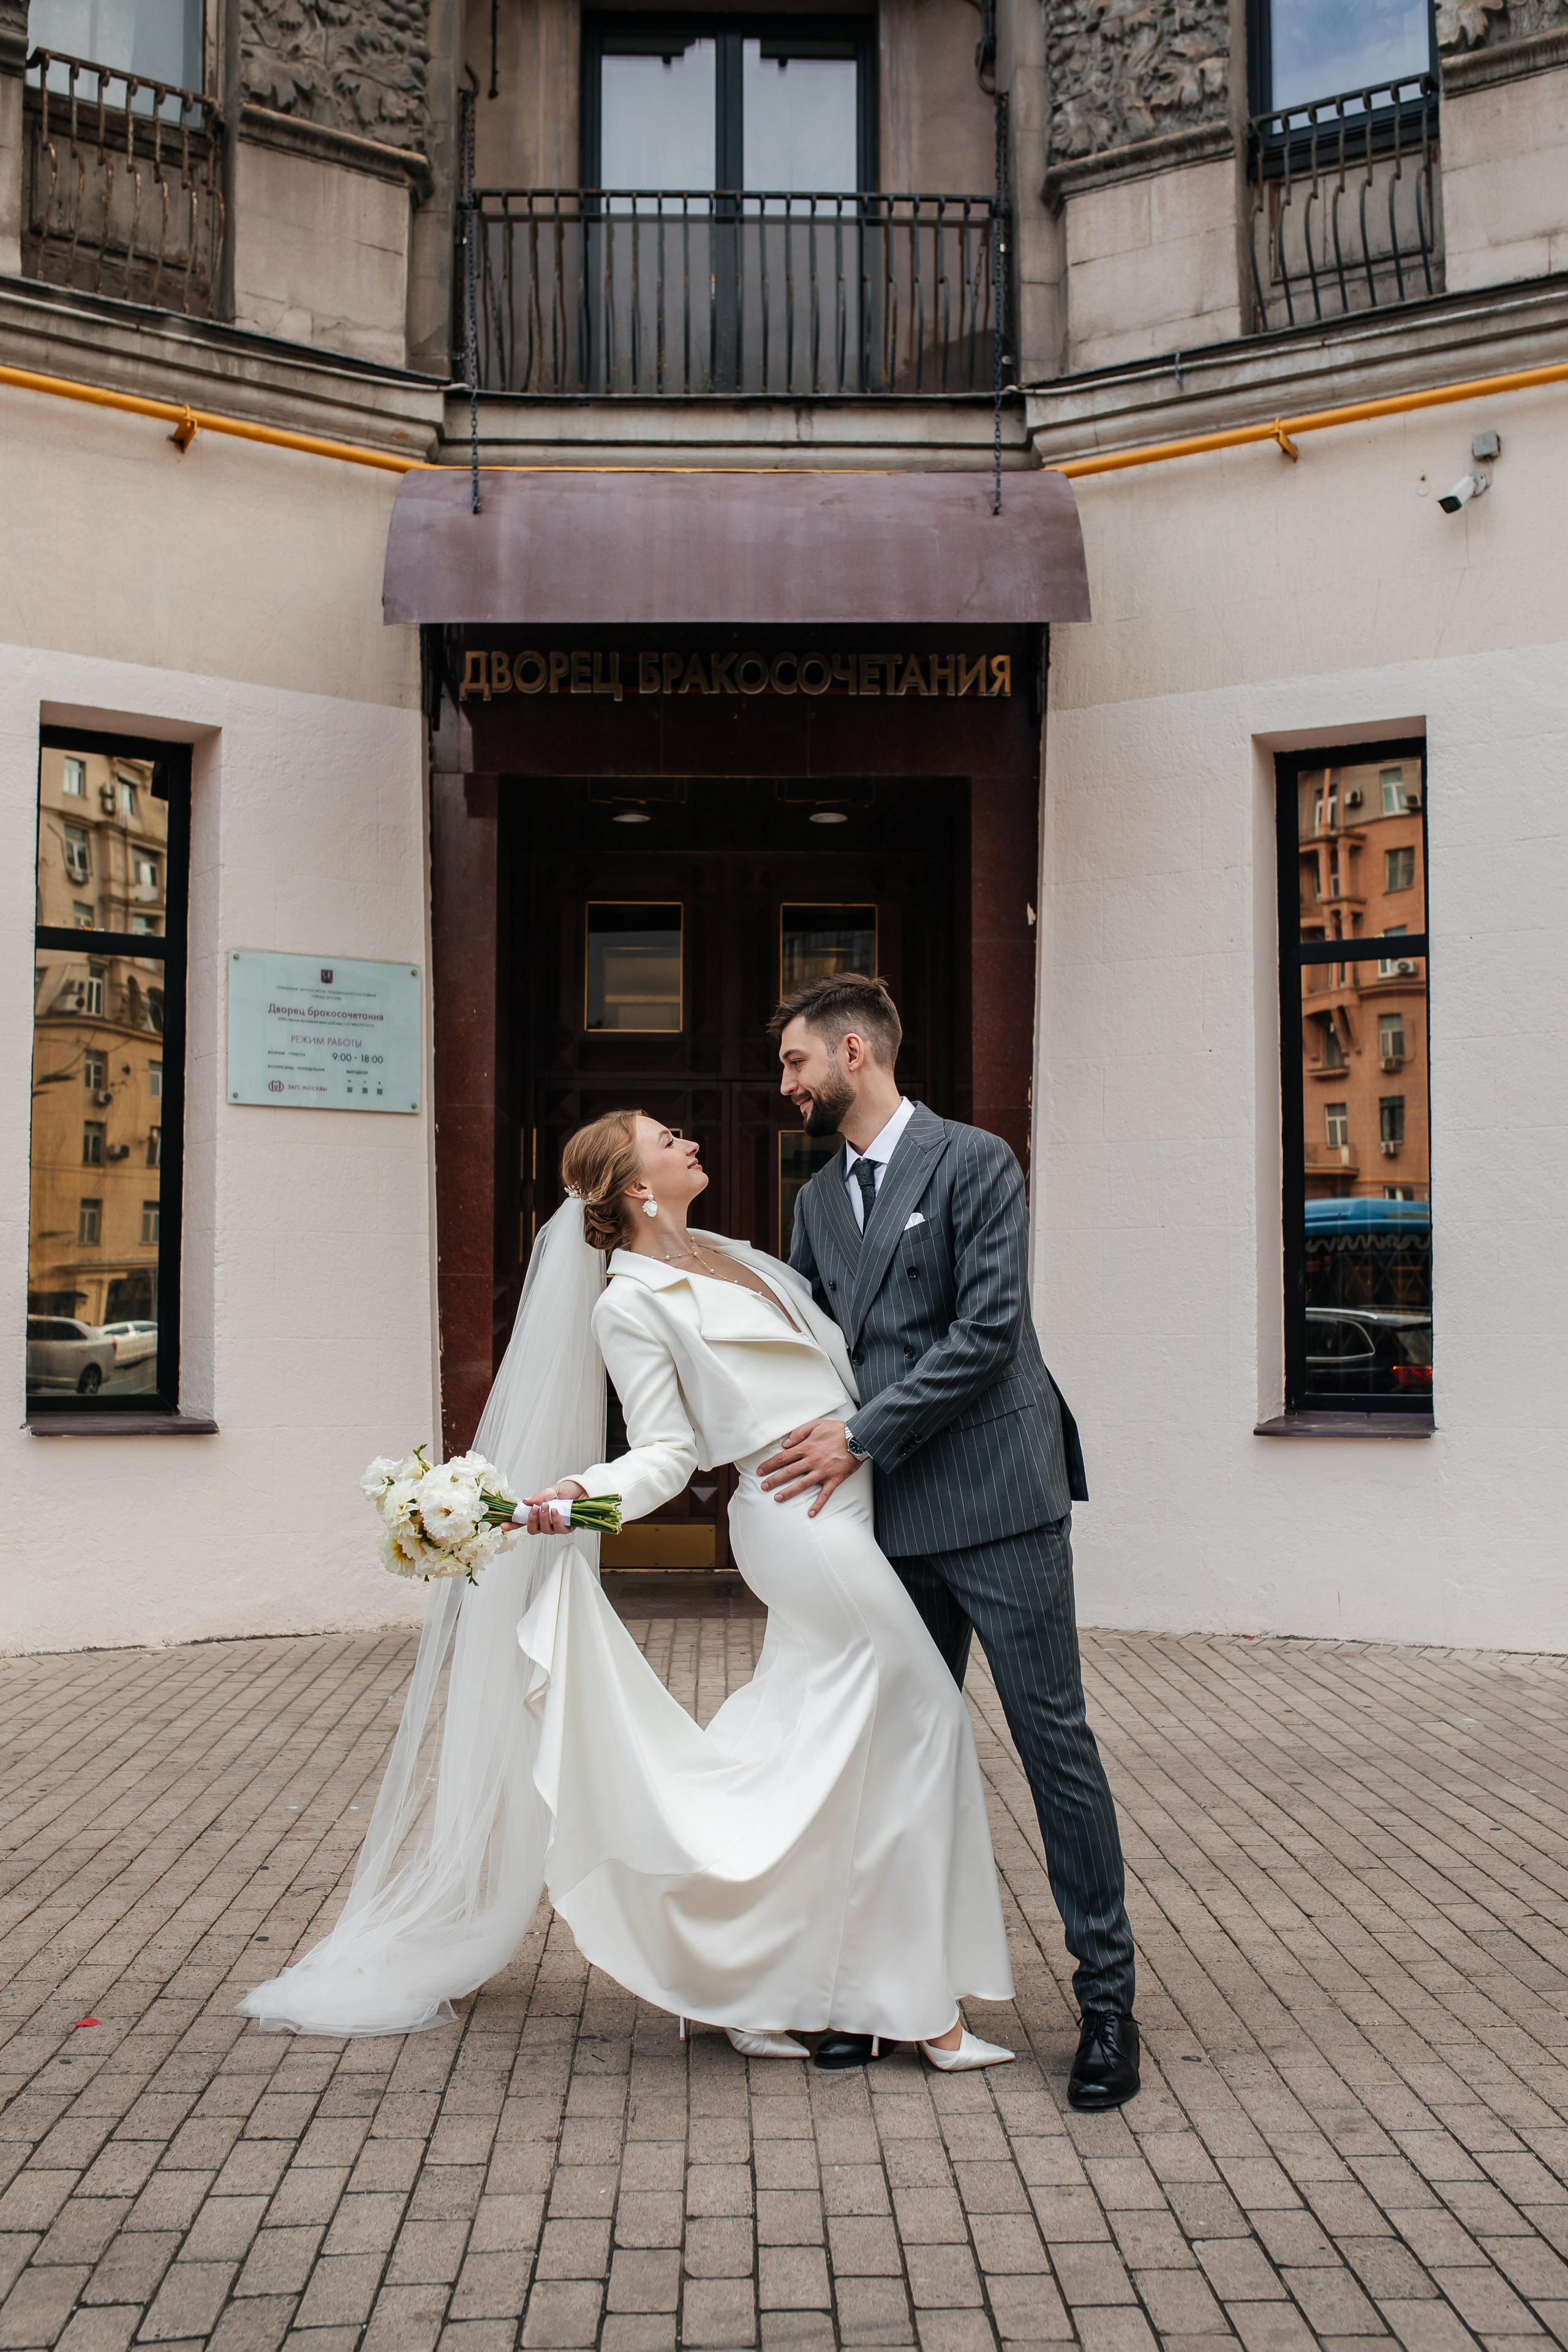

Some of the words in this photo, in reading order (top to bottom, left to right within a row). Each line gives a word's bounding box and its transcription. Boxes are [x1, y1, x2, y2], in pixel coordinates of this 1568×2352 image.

[459, 650, 622, 701] ДВОРЕЦ
[639, 652, 1011, 696] БРАКОСОЧЕТАНИЯ
[268, 1003, 305, 1016] Дворец
[307, 1006, 383, 1021] бракосочетания
[291, 1035, 324, 1045] РЕЖИМ
[327, 1038, 361, 1048] РАБОТЫ
[332, 1052, 352, 1061] 9:00
[361, 1054, 383, 1064] 18:00
